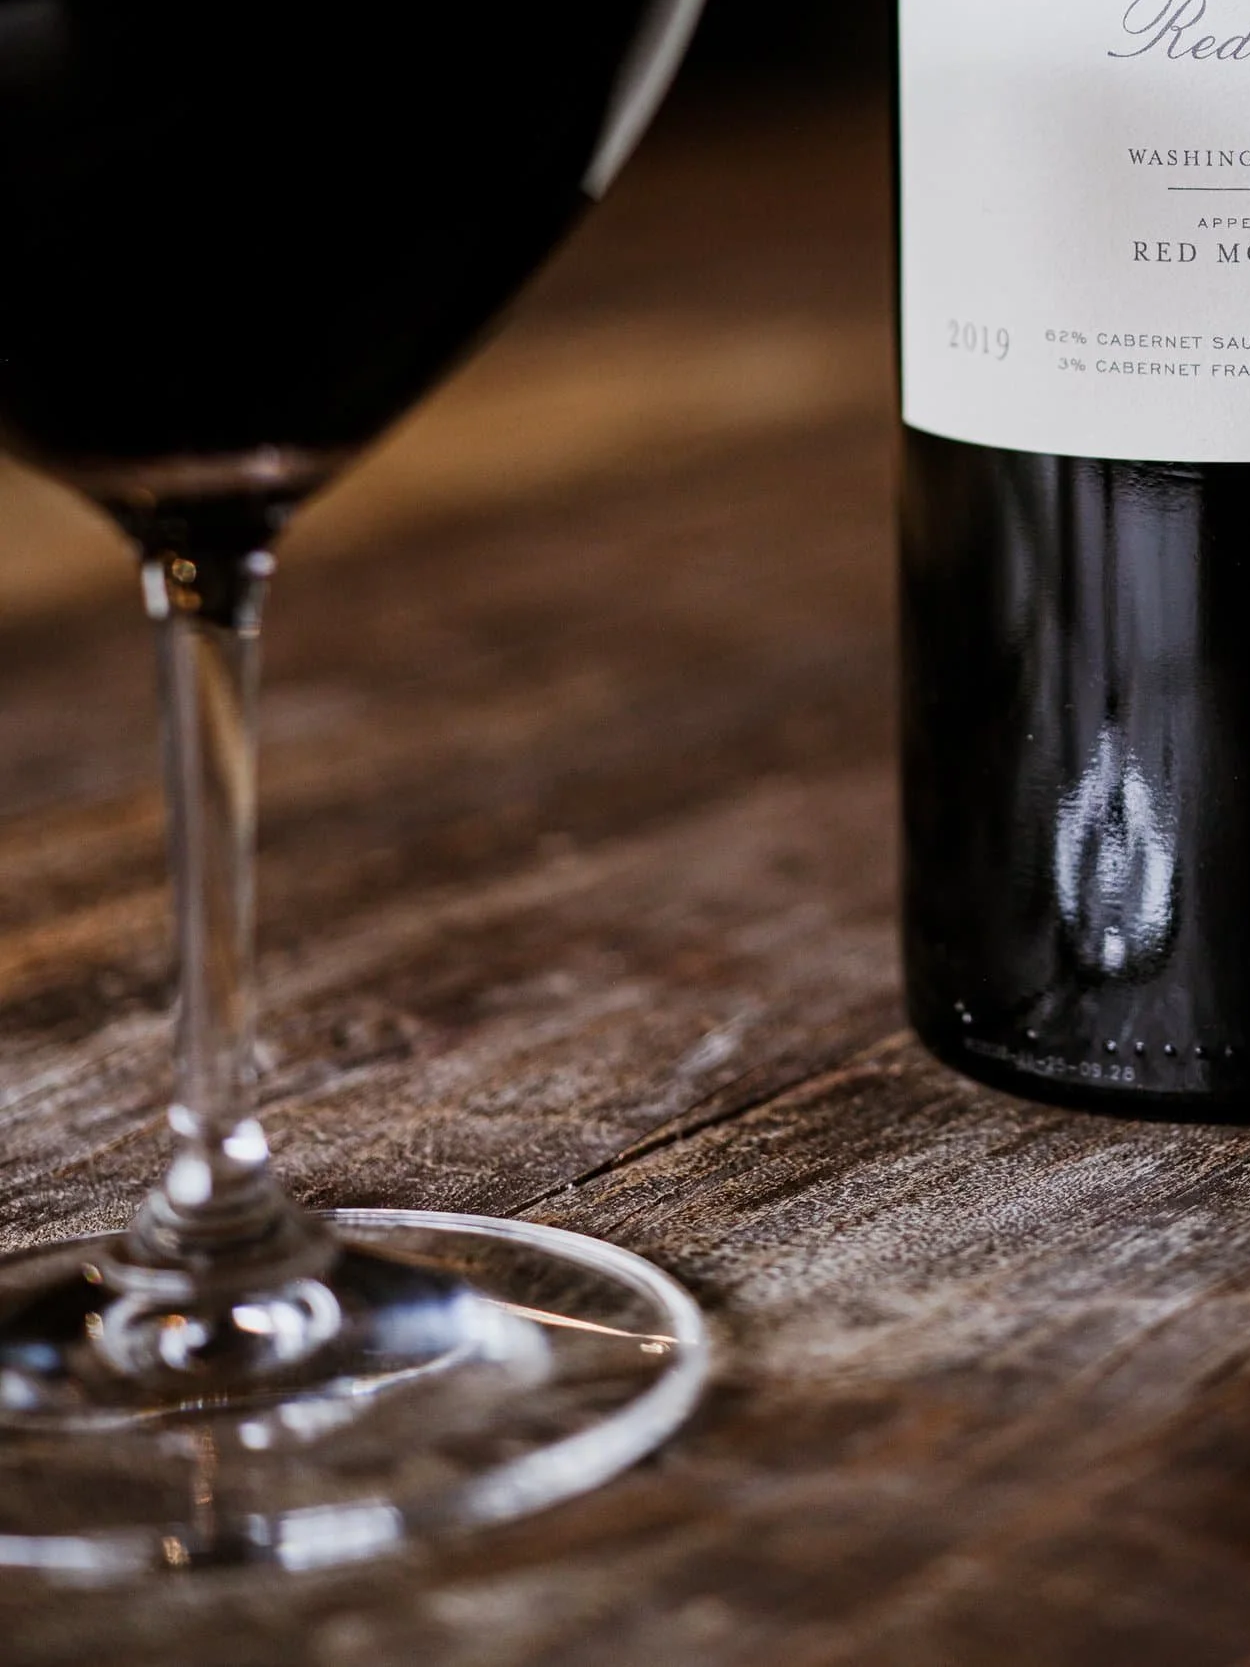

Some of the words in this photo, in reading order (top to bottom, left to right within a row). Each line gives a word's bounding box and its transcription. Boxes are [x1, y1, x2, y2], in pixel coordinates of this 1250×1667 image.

[1133, 241, 1197, 262] RED
[949, 320, 1010, 361] 2019
[1045, 329, 1087, 345] 62%
[1097, 332, 1202, 349] CABERNET
[1058, 357, 1086, 372] 3%
[1095, 359, 1201, 377] CABERNET
